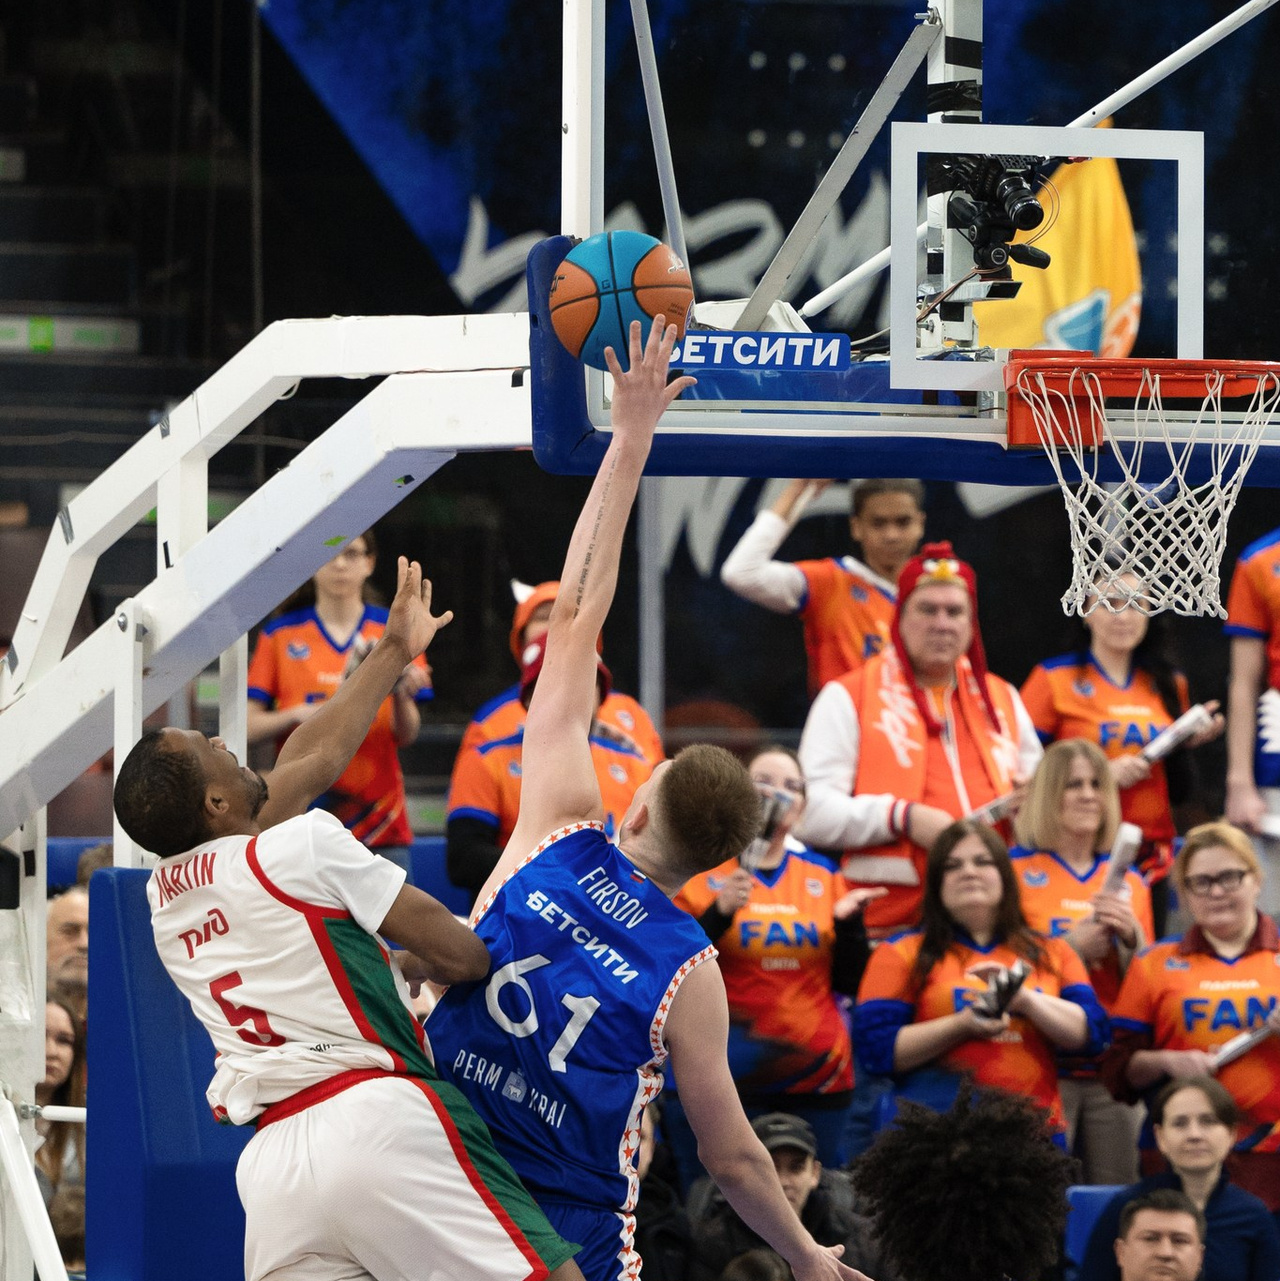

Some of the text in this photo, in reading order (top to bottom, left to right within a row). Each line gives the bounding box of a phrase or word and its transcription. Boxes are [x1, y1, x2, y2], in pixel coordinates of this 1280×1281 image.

[669, 335, 841, 367] ЕТСИТИ
[154, 851, 217, 908] MARTIN
[576, 865, 649, 931] FIRSOV
[525, 889, 640, 985] БЕТСИТИ
[739, 921, 820, 948] FAN
[208, 970, 287, 1048] 5
[484, 953, 602, 1074] 61
[1182, 994, 1279, 1033] FAN
[451, 1048, 567, 1130] PERM KRAI
